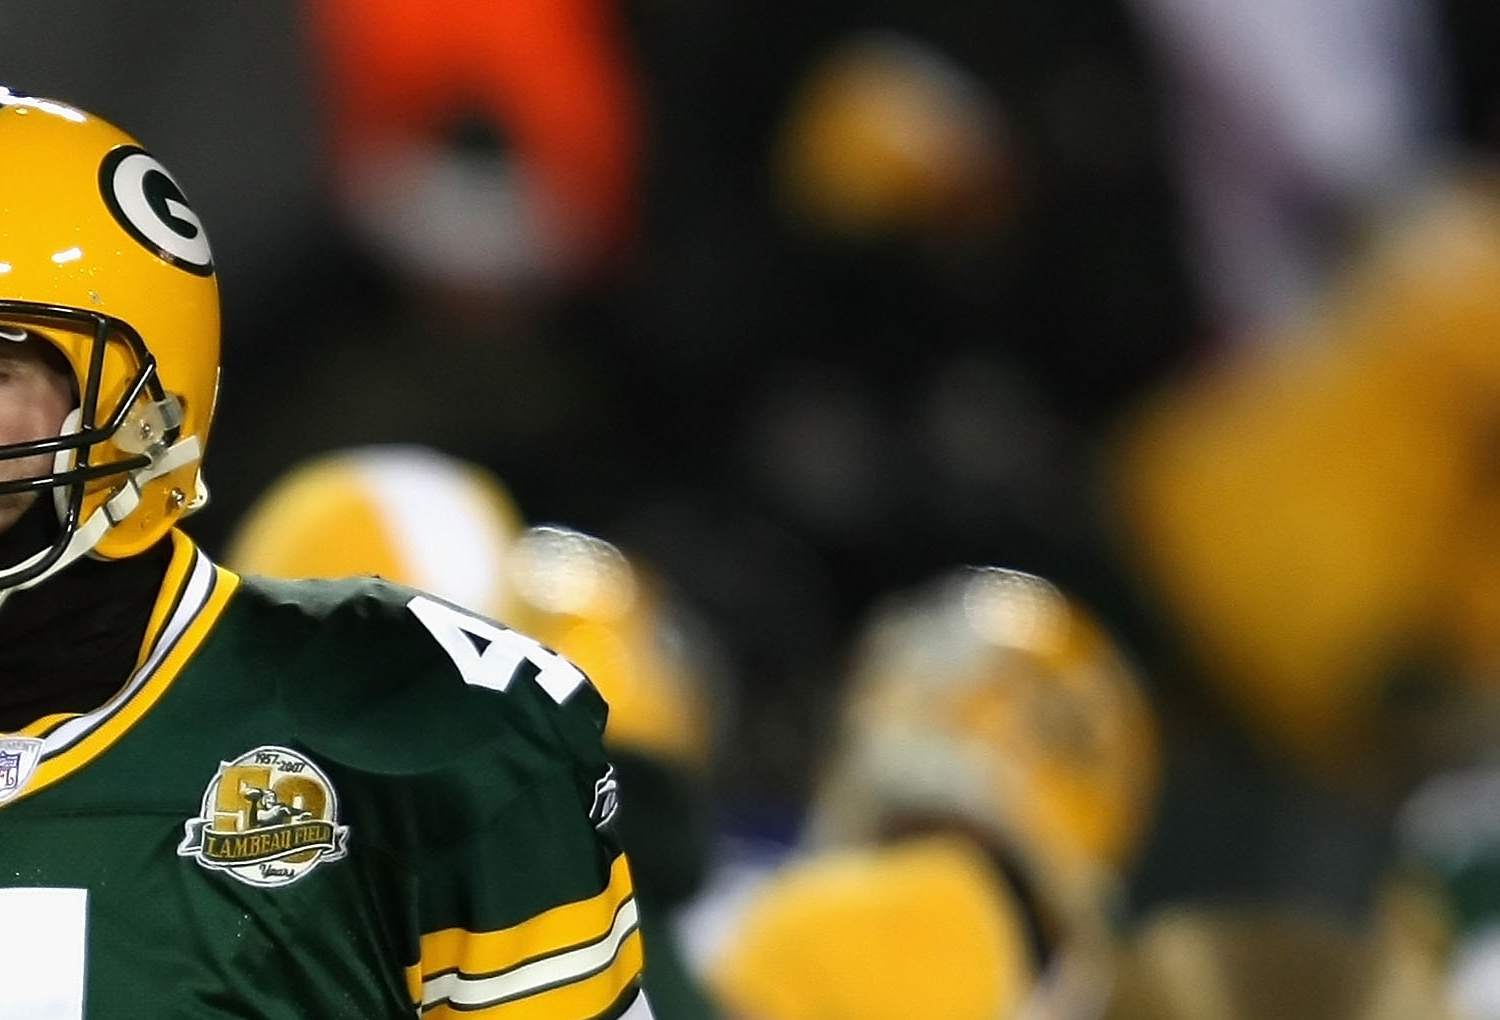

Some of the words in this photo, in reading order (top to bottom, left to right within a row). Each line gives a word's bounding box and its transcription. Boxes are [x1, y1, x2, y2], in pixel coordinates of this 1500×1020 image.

[111, 153, 212, 266] G
[406, 596, 585, 704] 4
[206, 829, 291, 858] LAMBEAU
[294, 825, 330, 844] FIELD
